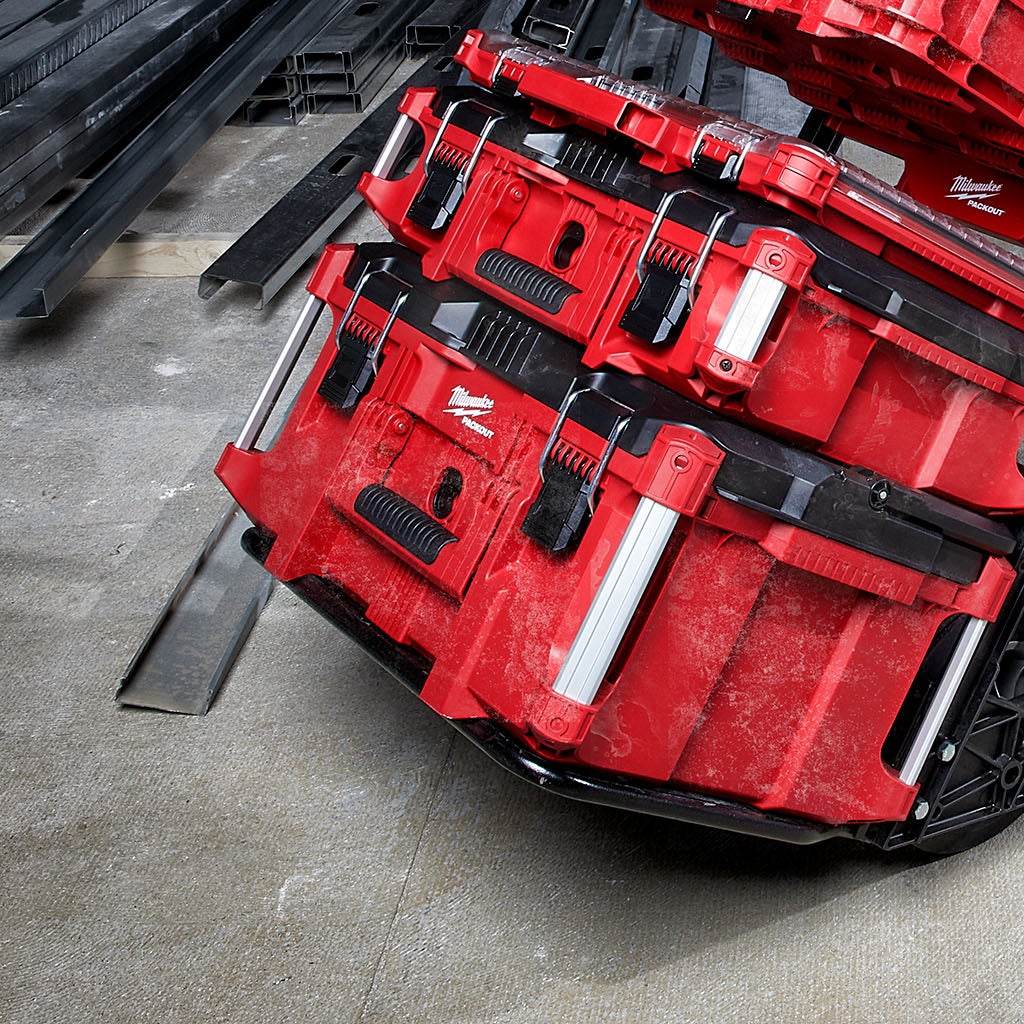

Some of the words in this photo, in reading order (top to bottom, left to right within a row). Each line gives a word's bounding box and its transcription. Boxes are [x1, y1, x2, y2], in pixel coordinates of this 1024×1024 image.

[950, 174, 1003, 193] Milwaukee
[967, 199, 1006, 217] PACKOUT
[448, 384, 495, 409] Milwaukee
[461, 416, 495, 439] PACKOUT
